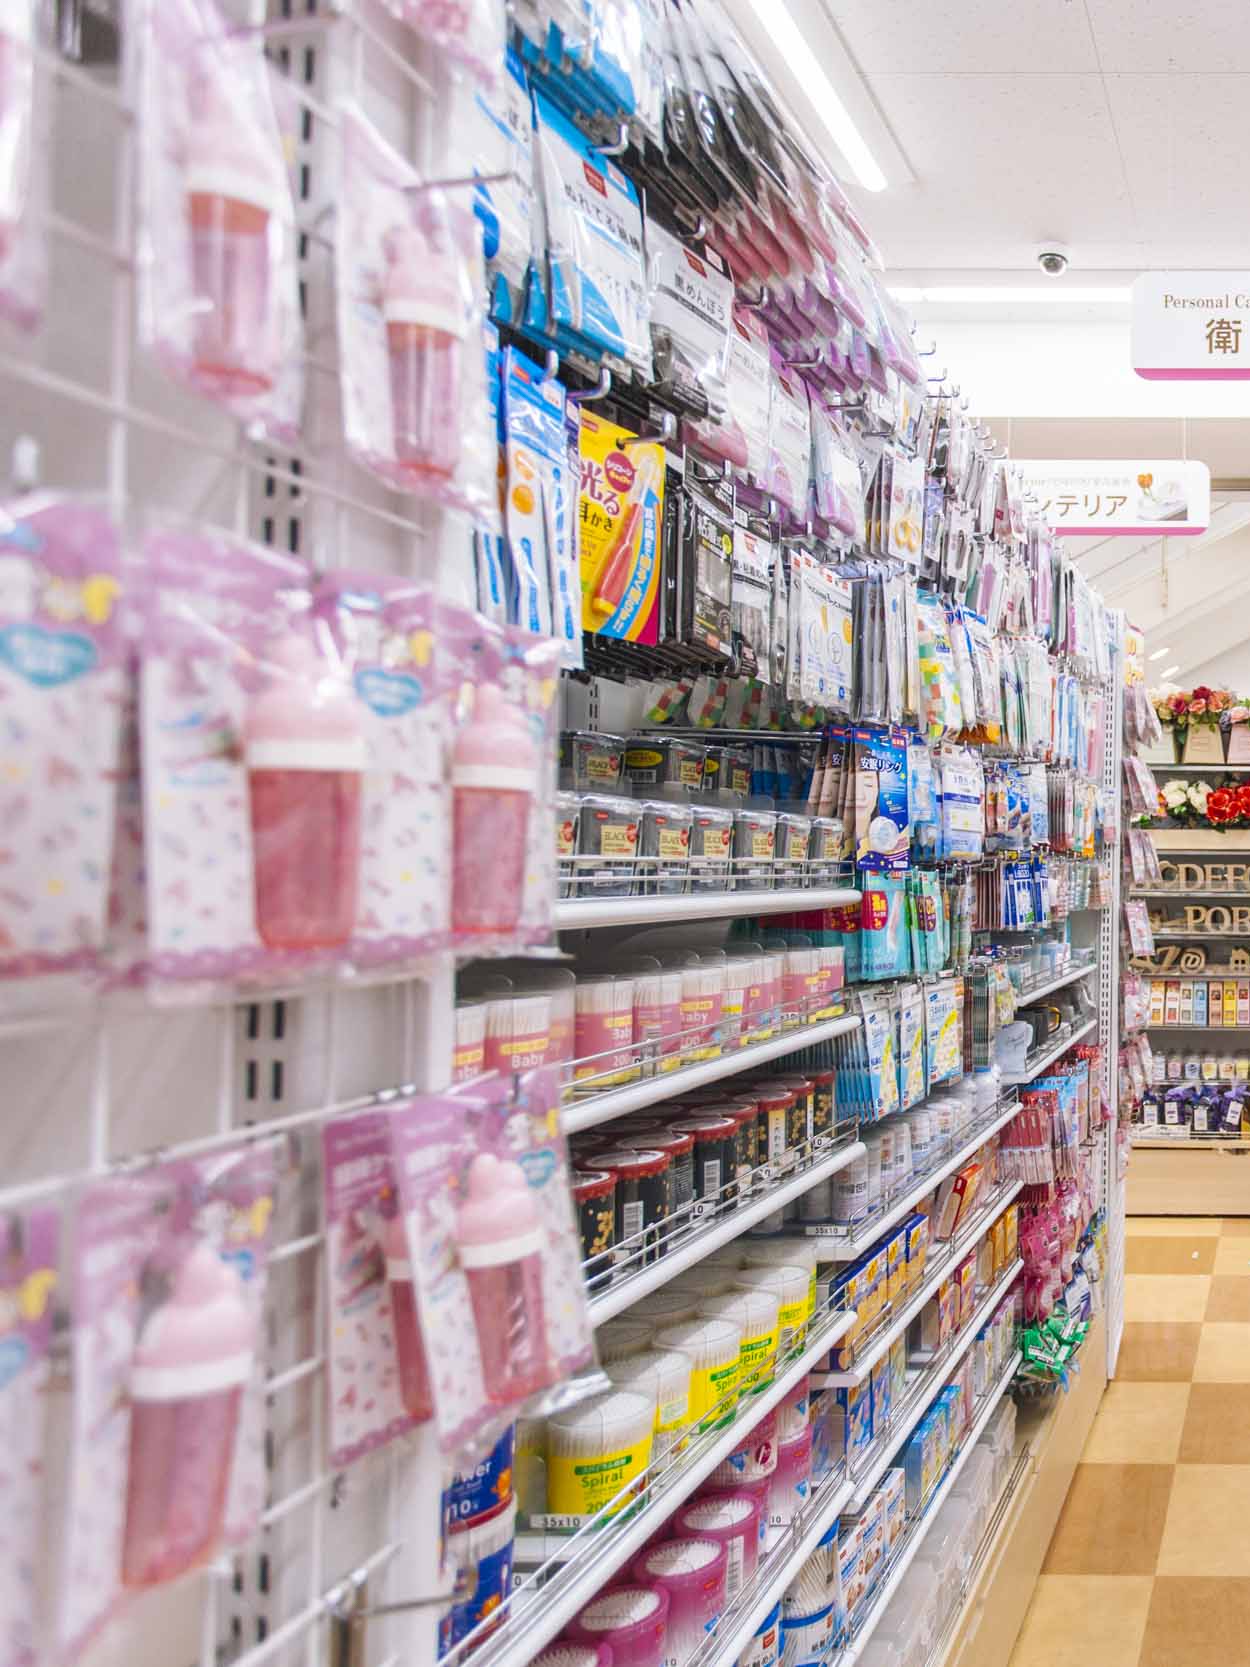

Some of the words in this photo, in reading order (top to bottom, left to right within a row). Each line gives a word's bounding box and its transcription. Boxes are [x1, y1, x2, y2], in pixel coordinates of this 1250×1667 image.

[1163, 293, 1229, 309] Personal
[860, 757, 903, 773] 安眠リング
[581, 1470, 624, 1490] Spiral
